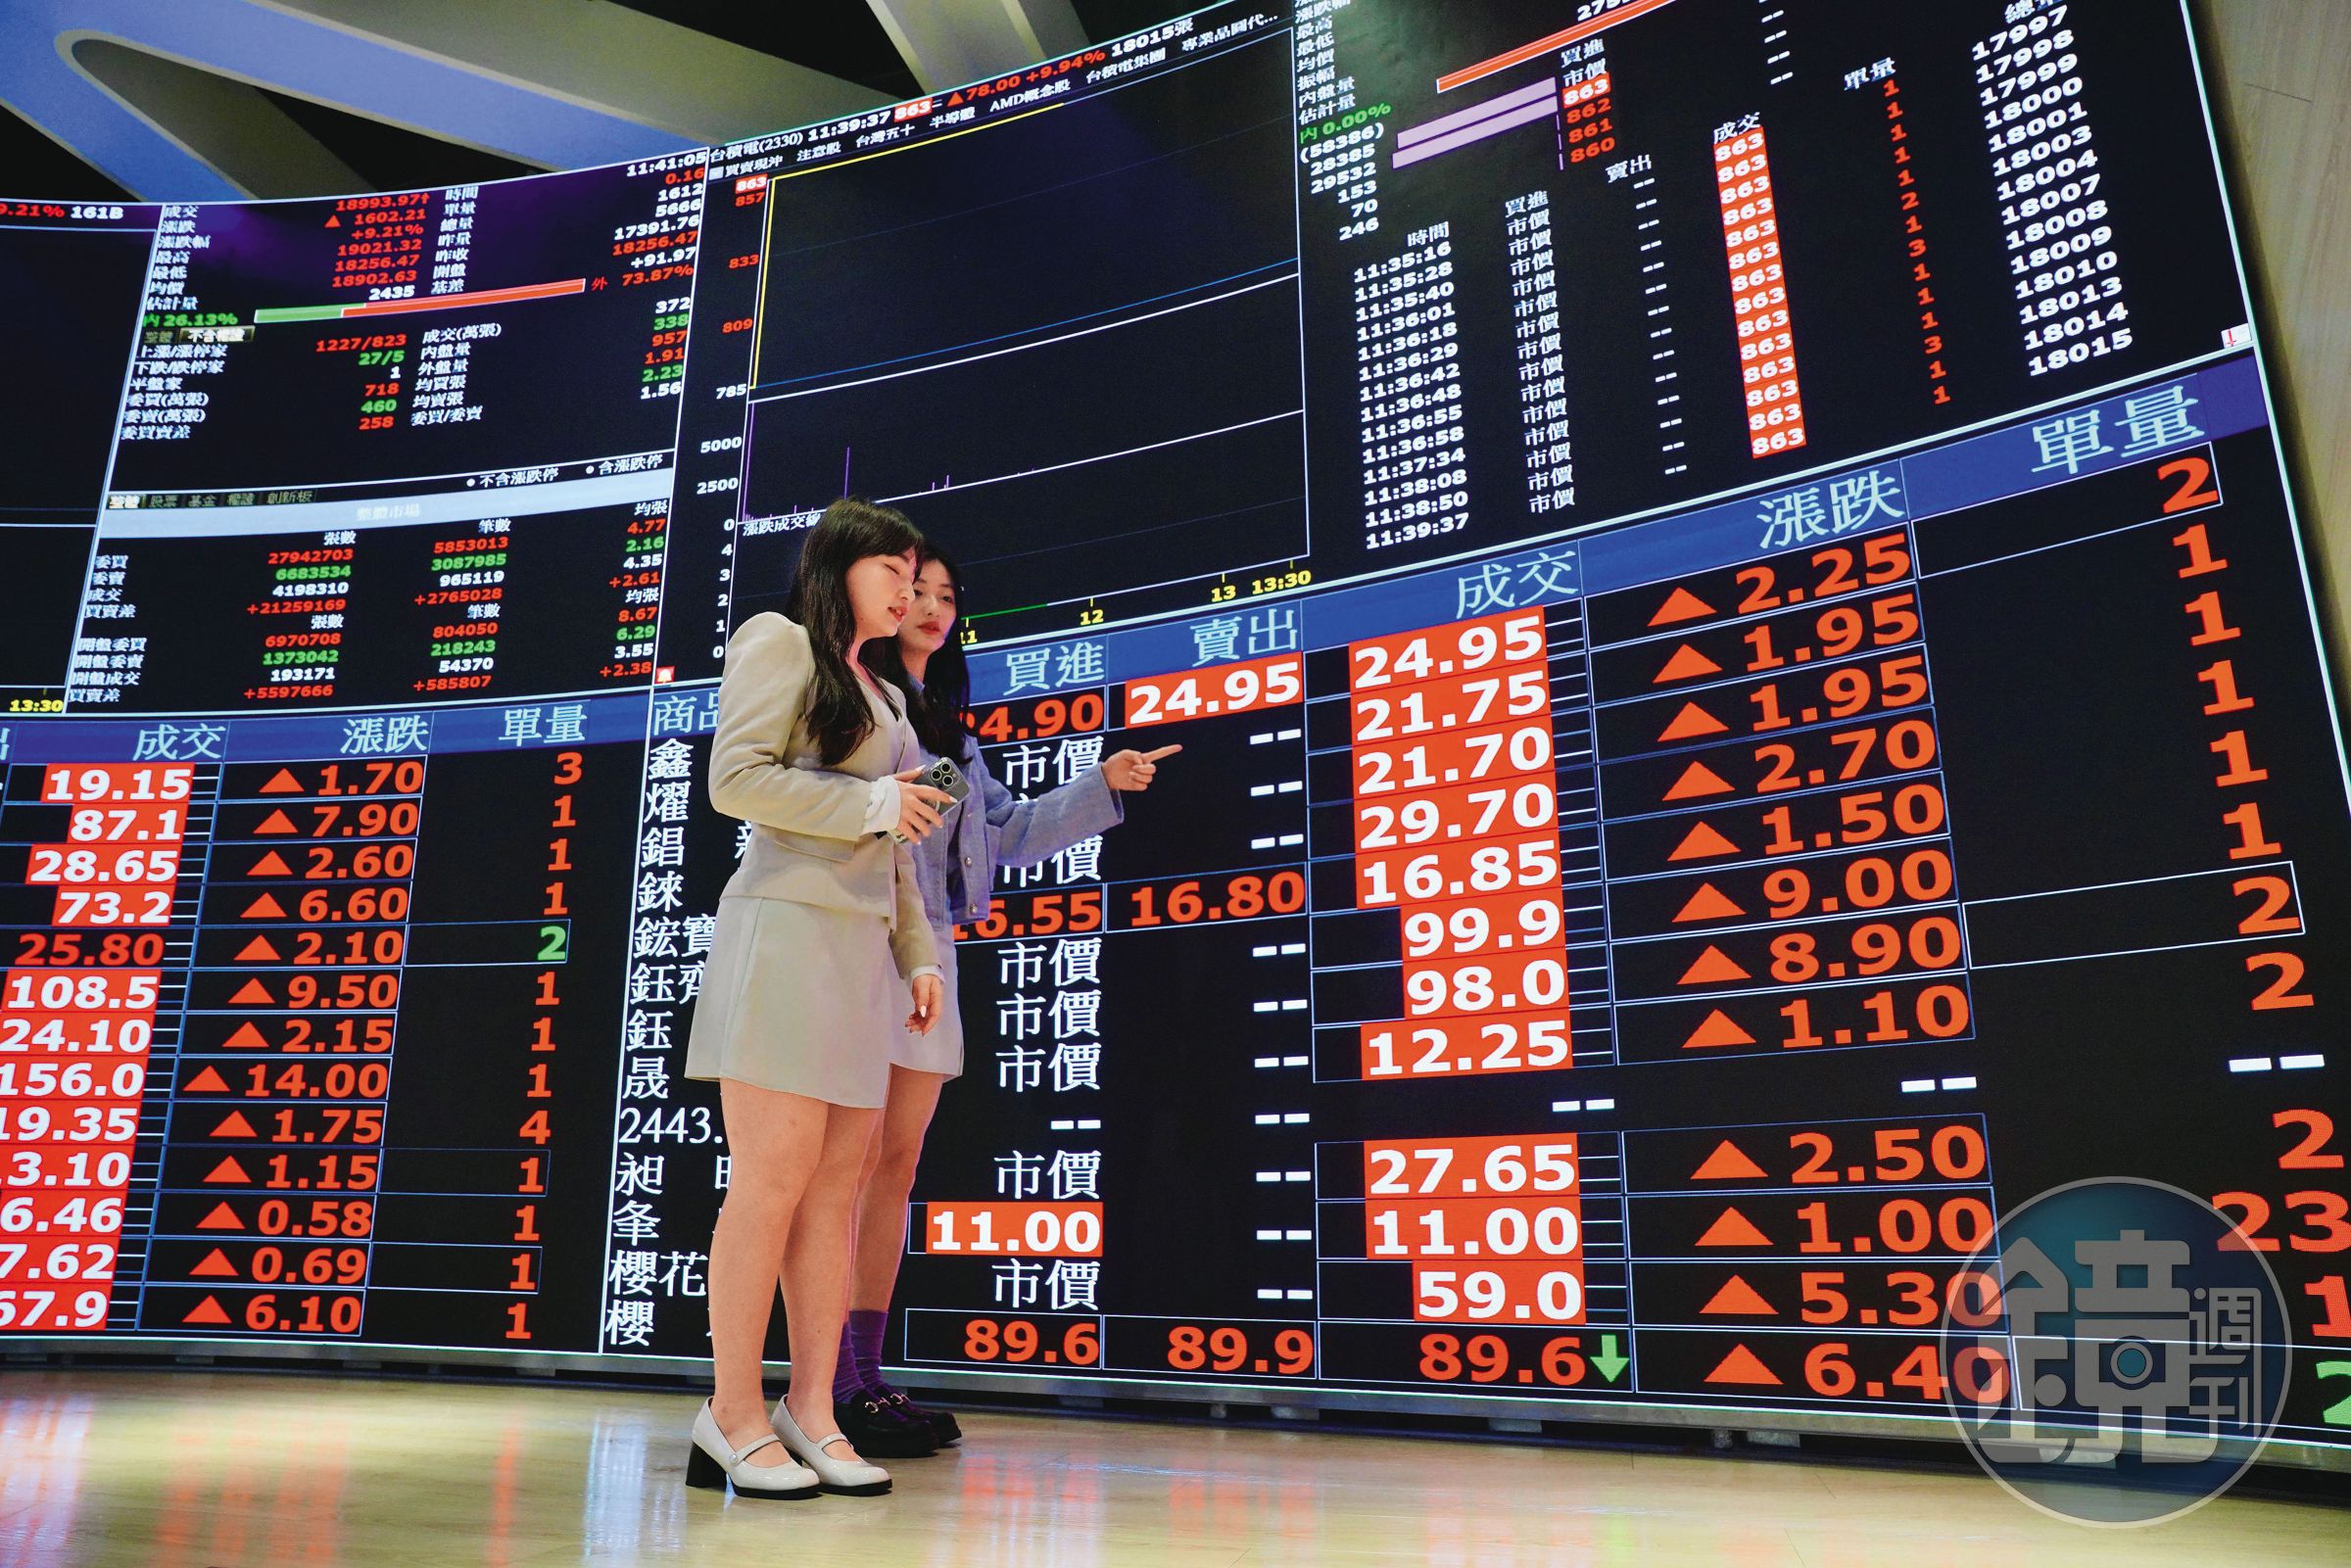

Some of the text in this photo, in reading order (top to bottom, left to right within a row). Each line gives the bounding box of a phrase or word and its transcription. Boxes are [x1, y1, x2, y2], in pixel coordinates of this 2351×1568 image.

[1972, 6, 2068, 61] 17997
[1560, 39, 1605, 67] 買進
[1562, 60, 1607, 86] 市價
[807, 111, 891, 141] 11:39:37
[895, 100, 932, 119] 863
[966, 75, 1021, 101] 78.00
[1027, 50, 1106, 81] +9.94%
[1564, 79, 1608, 104] 863
[1984, 77, 2083, 129] 18000
[1323, 103, 1392, 135] 0.00%
[1568, 119, 1613, 143] 861
[1713, 112, 1760, 144] 成交
[1300, 123, 1384, 163] (58386)
[1311, 145, 1375, 175] 28385
[1714, 133, 1763, 162] 863
[627, 152, 707, 177] 11:41:05
[1606, 155, 1652, 183] 賣出
[446, 186, 478, 200] 時間
[655, 200, 701, 217] 5666
[1338, 181, 1376, 203] 153
[1351, 199, 1377, 217] 70
[1901, 192, 1920, 210] 2
[2001, 174, 2101, 225] 18007
[614, 215, 699, 240] 17391.76
[1339, 217, 1379, 240] 246
[1408, 222, 1450, 246] 時間
[1507, 210, 1551, 235] 市價
[612, 231, 697, 256] 18256.47
[631, 247, 696, 268] +91.97
[1909, 240, 1927, 257] 3
[622, 264, 695, 286] 73.87%
[1354, 242, 1451, 282] 11:35:16
[2015, 252, 2118, 299] 18010
[164, 313, 238, 326] 26.13%
[655, 298, 691, 313] 372
[1357, 302, 1456, 342] 11:36:01
[315, 334, 407, 353] 1227/823
[651, 330, 687, 346] 957
[2028, 329, 2133, 376] 18015
[640, 382, 682, 400] 1.56
[716, 384, 747, 400] 785
[1361, 384, 1462, 422] 11:36:48
[700, 437, 743, 453] 5000
[1751, 428, 1804, 454] 863
[1364, 448, 1465, 485] 11:37:34
[268, 518, 666, 564] 27942703 5853013 4.77
[1003, 641, 1105, 696] 買進
[1190, 608, 1298, 667] 賣出
[1457, 550, 1578, 619] 成交
[1755, 470, 1905, 548] 漲跌
[2031, 385, 2205, 474] 單量
[1367, 512, 1469, 549] 11:39:37
[272, 554, 662, 597] 4198310 965119 4.35
[1212, 570, 1312, 602] 13 13:30
[648, 738, 694, 780] 鑫
[1128, 662, 1300, 724] 24.95
[1355, 615, 1542, 689] 24.95
[1736, 533, 1910, 614] 2.25
[2157, 457, 2219, 513] 2
[1357, 670, 1546, 740] 21.75
[1744, 594, 1919, 671] 1.95
[10, 700, 63, 712] 13:30
[133, 704, 588, 761] 成交 漲跌 單量
[1359, 727, 1550, 794] 21.70
[1750, 655, 1928, 731] 1.95
[47, 752, 583, 801] 19.15 1.70 3
[1360, 784, 1554, 849] 29.70
[1754, 720, 1936, 793] 2.70
[71, 802, 419, 841] 87.1 7.90
[30, 845, 413, 882] 28.65 2.60
[1130, 872, 1305, 926] 16.80
[1364, 840, 1557, 904] 16.85
[1762, 784, 1944, 855] 1.50
[58, 887, 408, 924] 73.2 6.60
[997, 850, 2300, 988] 市價 99.9 9.00 2
[15, 926, 567, 966] 25.80 2.10 2
[8, 975, 399, 1009] 108.5 9.50
[626, 917, 1960, 1051] 鈺 98.0 8.90
[0, 1019, 393, 1053] 24.10 2.15
[622, 985, 1969, 1099] 晟 12.25 1.10
[0, 1063, 389, 1098] 156.0 14.00
[272, 1110, 551, 1144] 1.75 4
[266, 1155, 377, 1189] 1.15
[615, 1155, 664, 1196] 昶
[994, 1150, 1101, 1200] 市價
[1369, 1145, 1575, 1194] 27.65
[1790, 1125, 1986, 1183] 2.50
[1, 1197, 372, 1236] 6.46 0.58
[932, 1212, 1100, 1251] 11.00
[1373, 1207, 1578, 1256] 11.00
[1797, 1198, 1993, 1253] 1.00
[2212, 1190, 2351, 1252] 23
[0, 1244, 366, 1283] 7.62 0.69
[608, 1251, 2001, 1327] 櫻花 市價 59.0 5.30
[245, 1295, 361, 1332] 6.10
[604, 1300, 2009, 1403] 櫻 89.6 89.9 89.6 6.40
